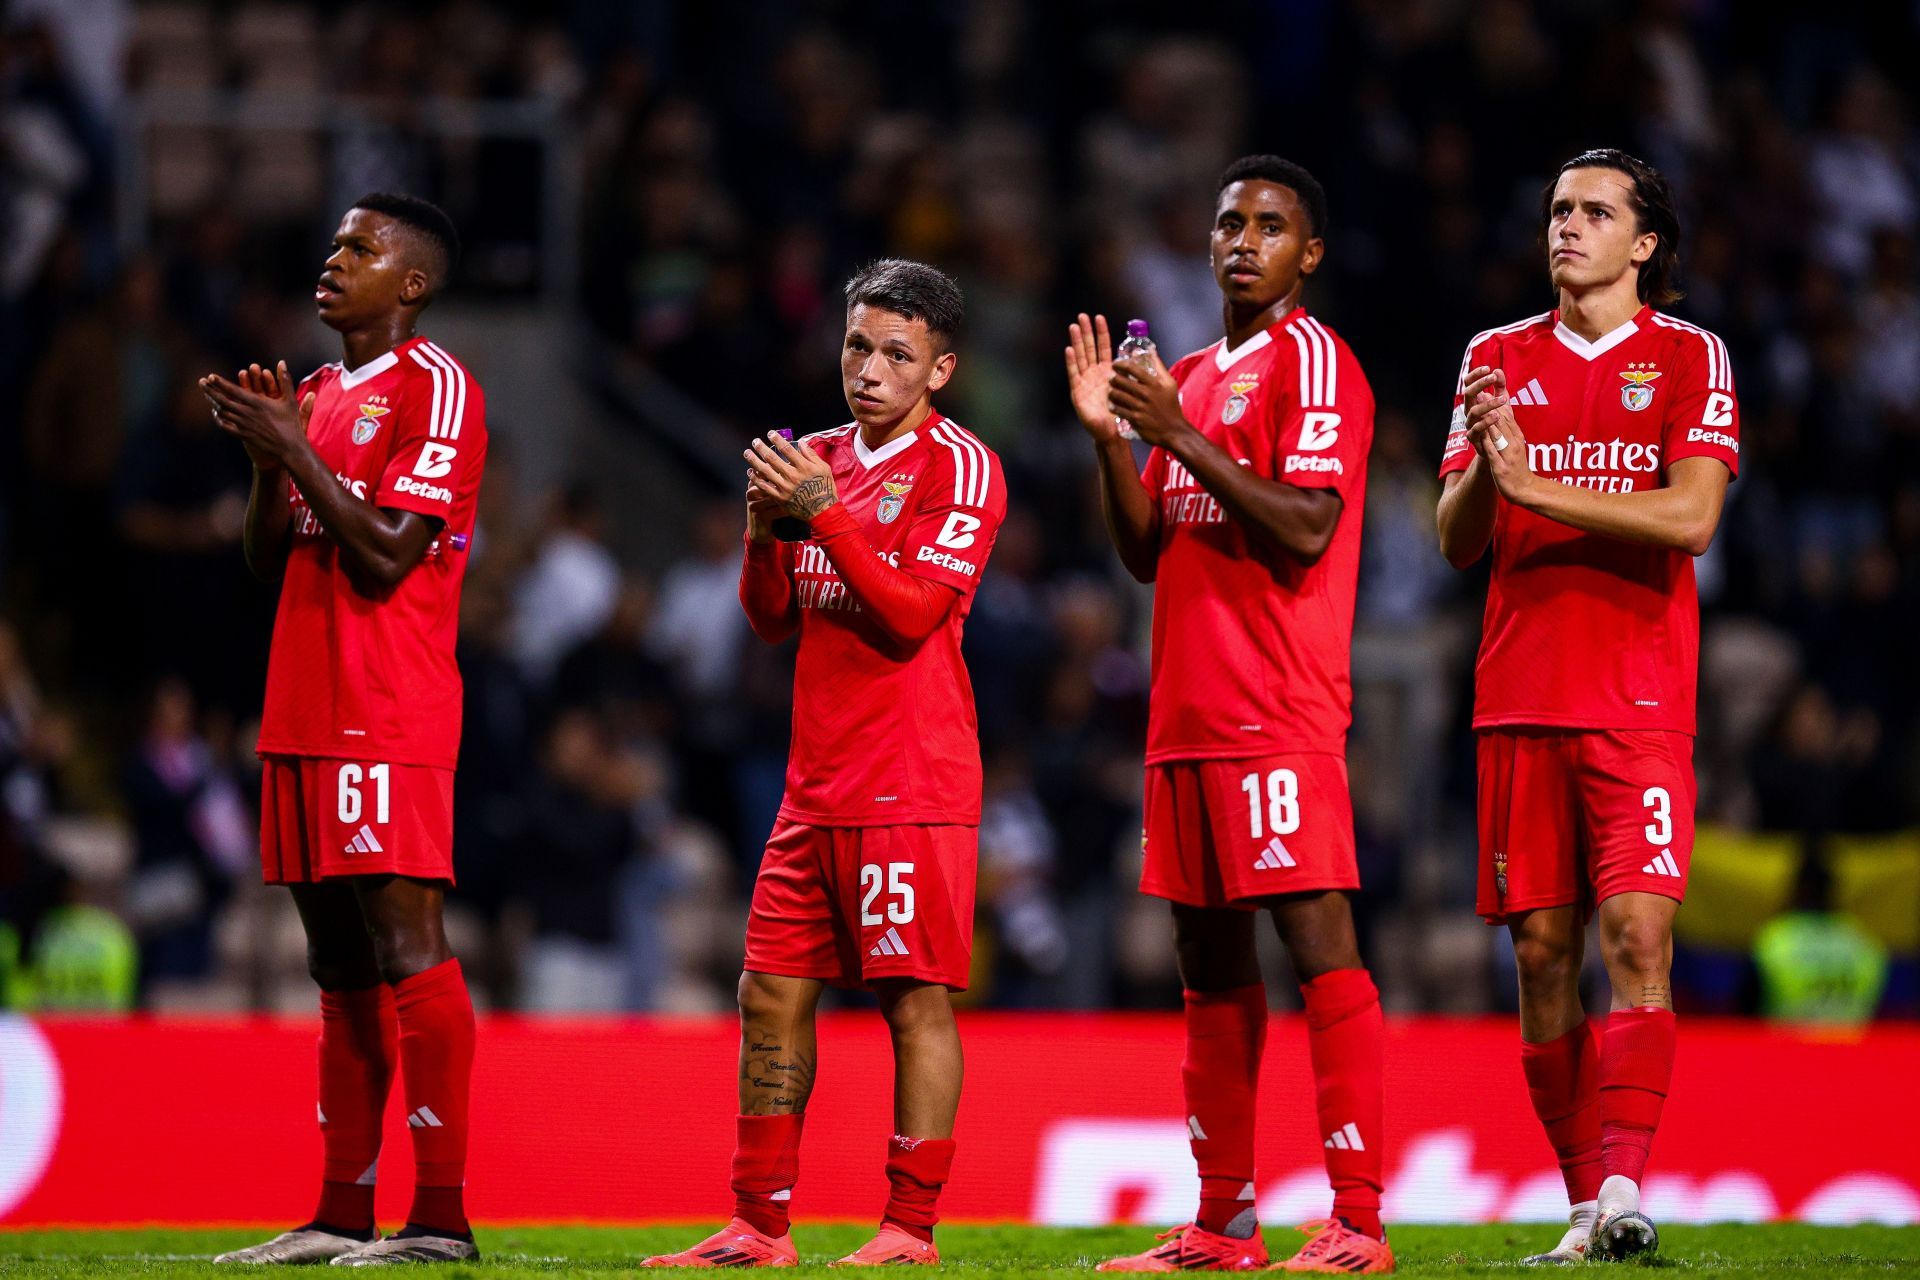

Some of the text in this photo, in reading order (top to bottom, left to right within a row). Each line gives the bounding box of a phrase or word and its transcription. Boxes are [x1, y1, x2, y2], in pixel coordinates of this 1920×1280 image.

[1525, 434, 1660, 472] mirates
[916, 545, 976, 577] Betano
[338, 763, 390, 824] 61
[1241, 768, 1300, 839] 18
[1642, 786, 1673, 846] 3
[860, 862, 915, 927] 25
